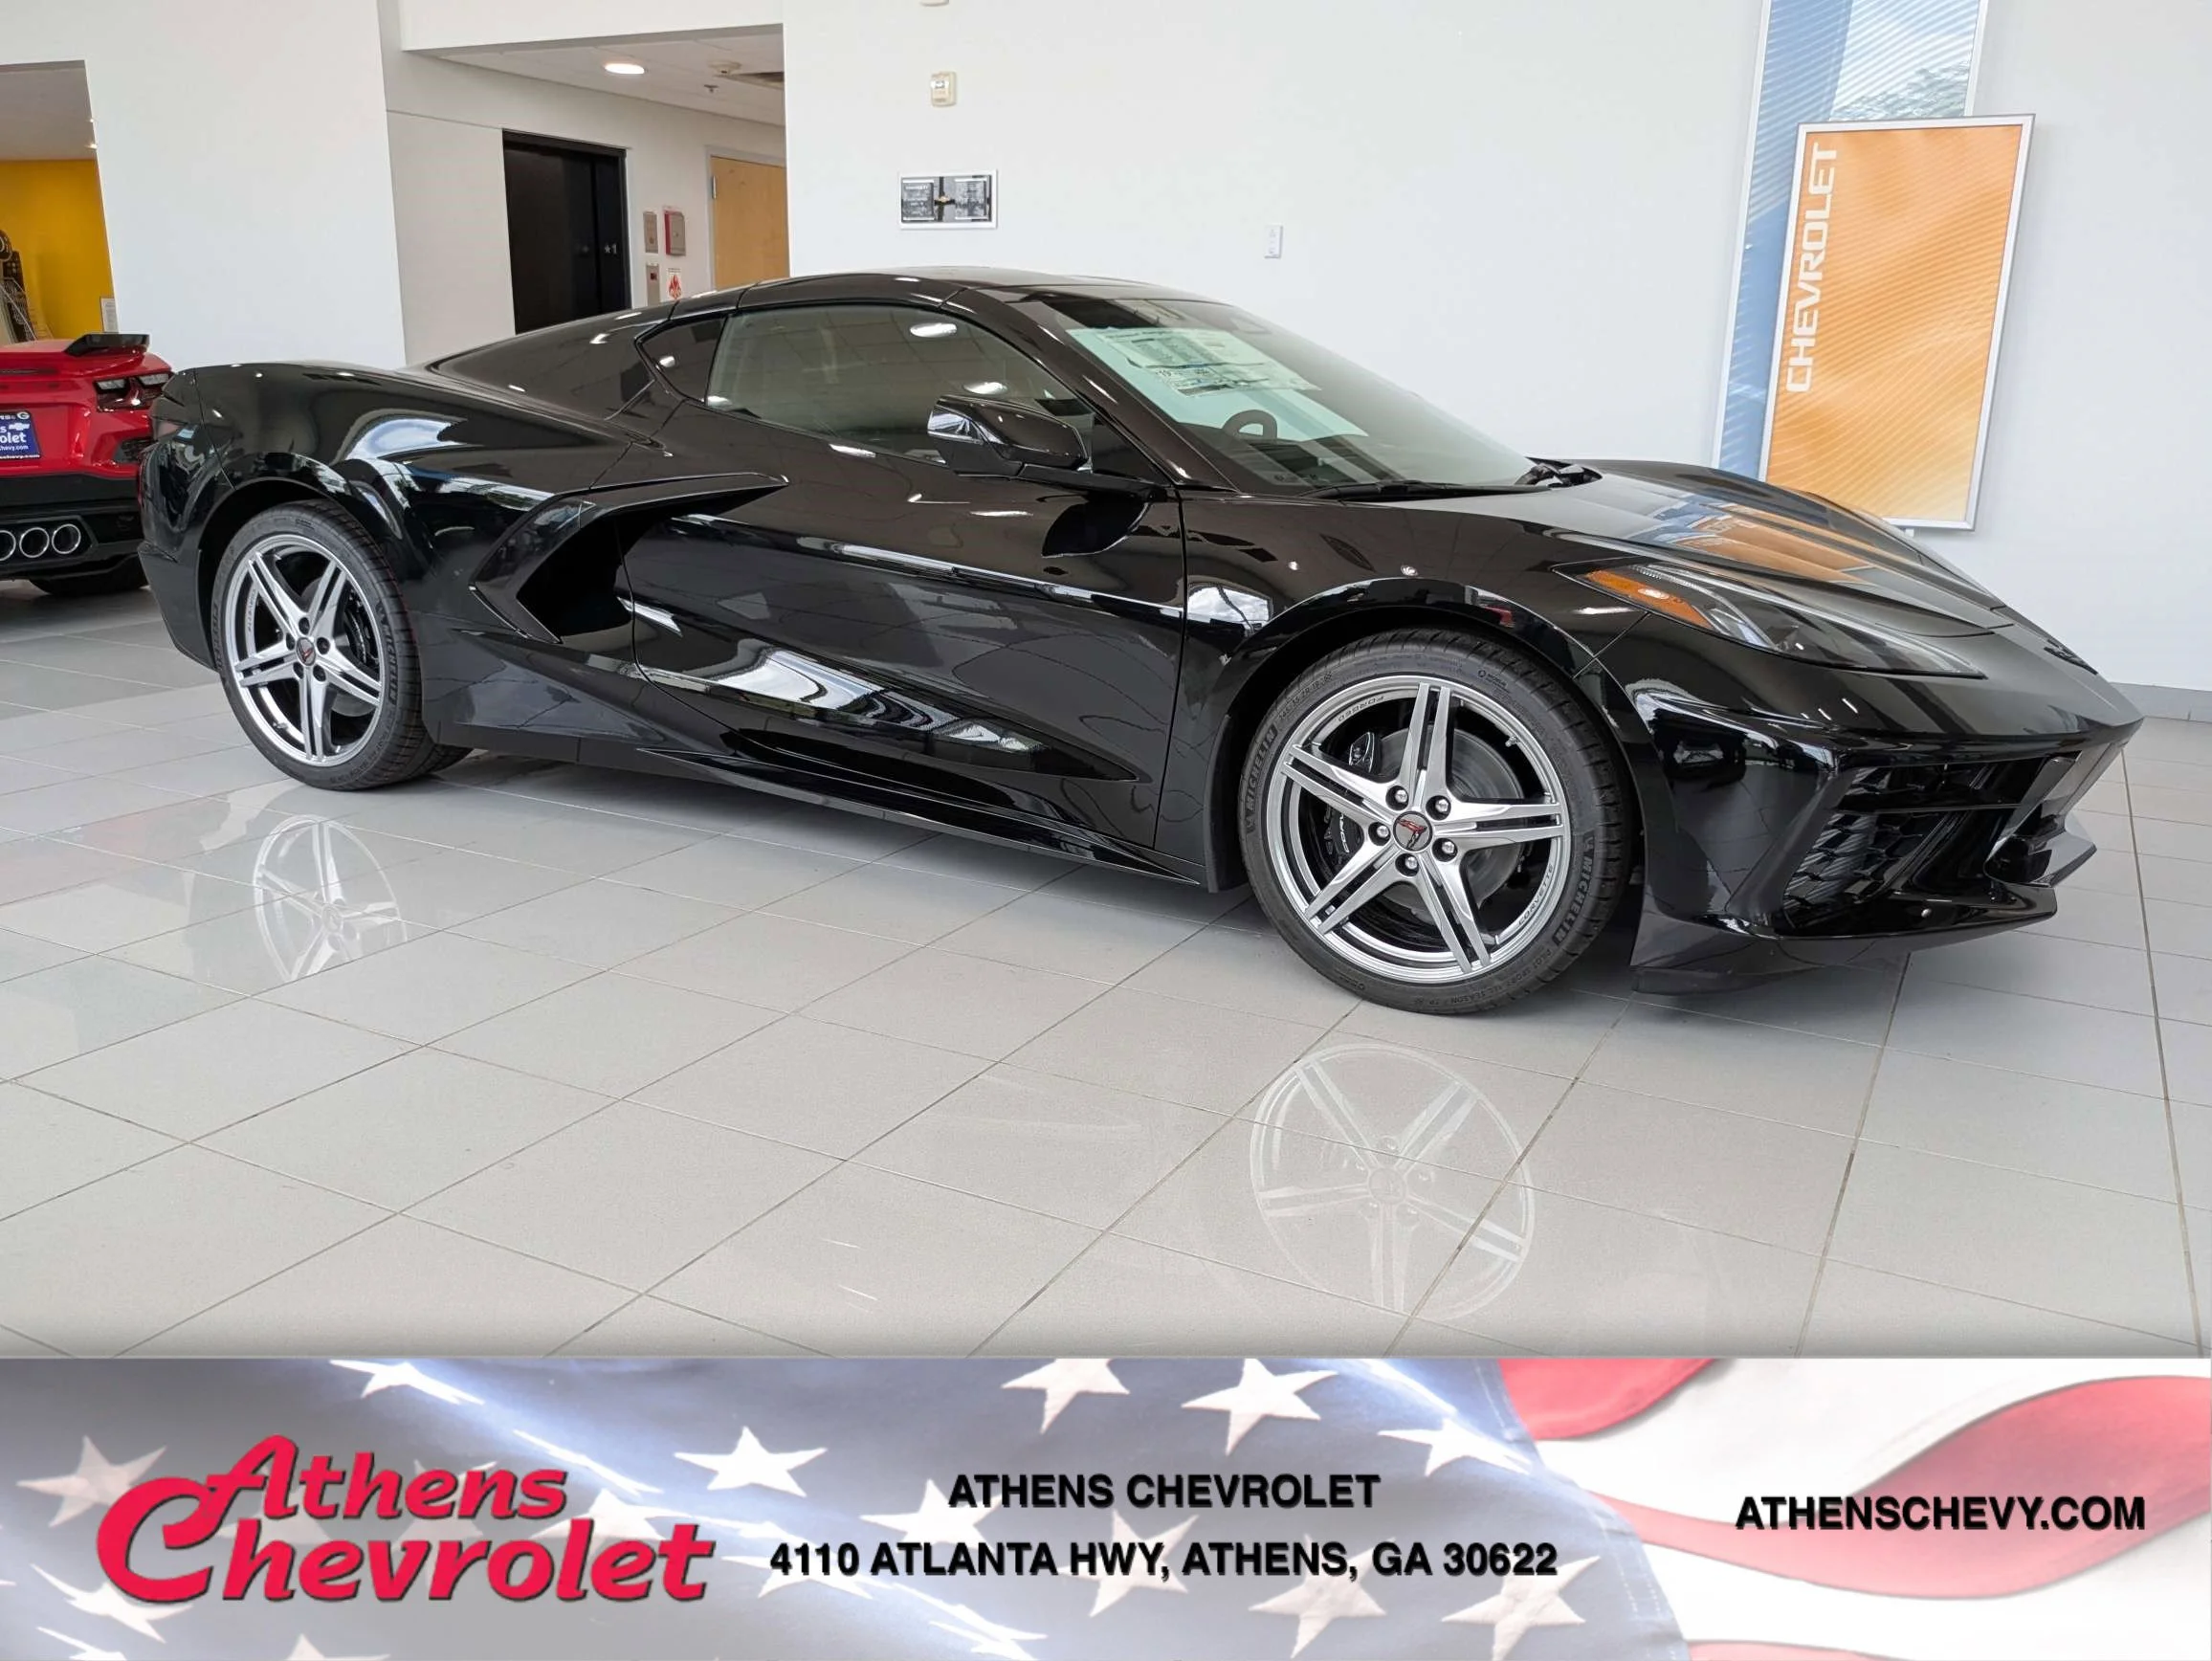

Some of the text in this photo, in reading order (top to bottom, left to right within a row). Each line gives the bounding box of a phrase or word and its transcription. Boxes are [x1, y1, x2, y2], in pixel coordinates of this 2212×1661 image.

[1785, 142, 1837, 392] CHEVROLET
[1246, 724, 1277, 812] MICHELIN
[1517, 863, 1554, 926] CORVETTE
[1553, 854, 1593, 944] MICHELIN
